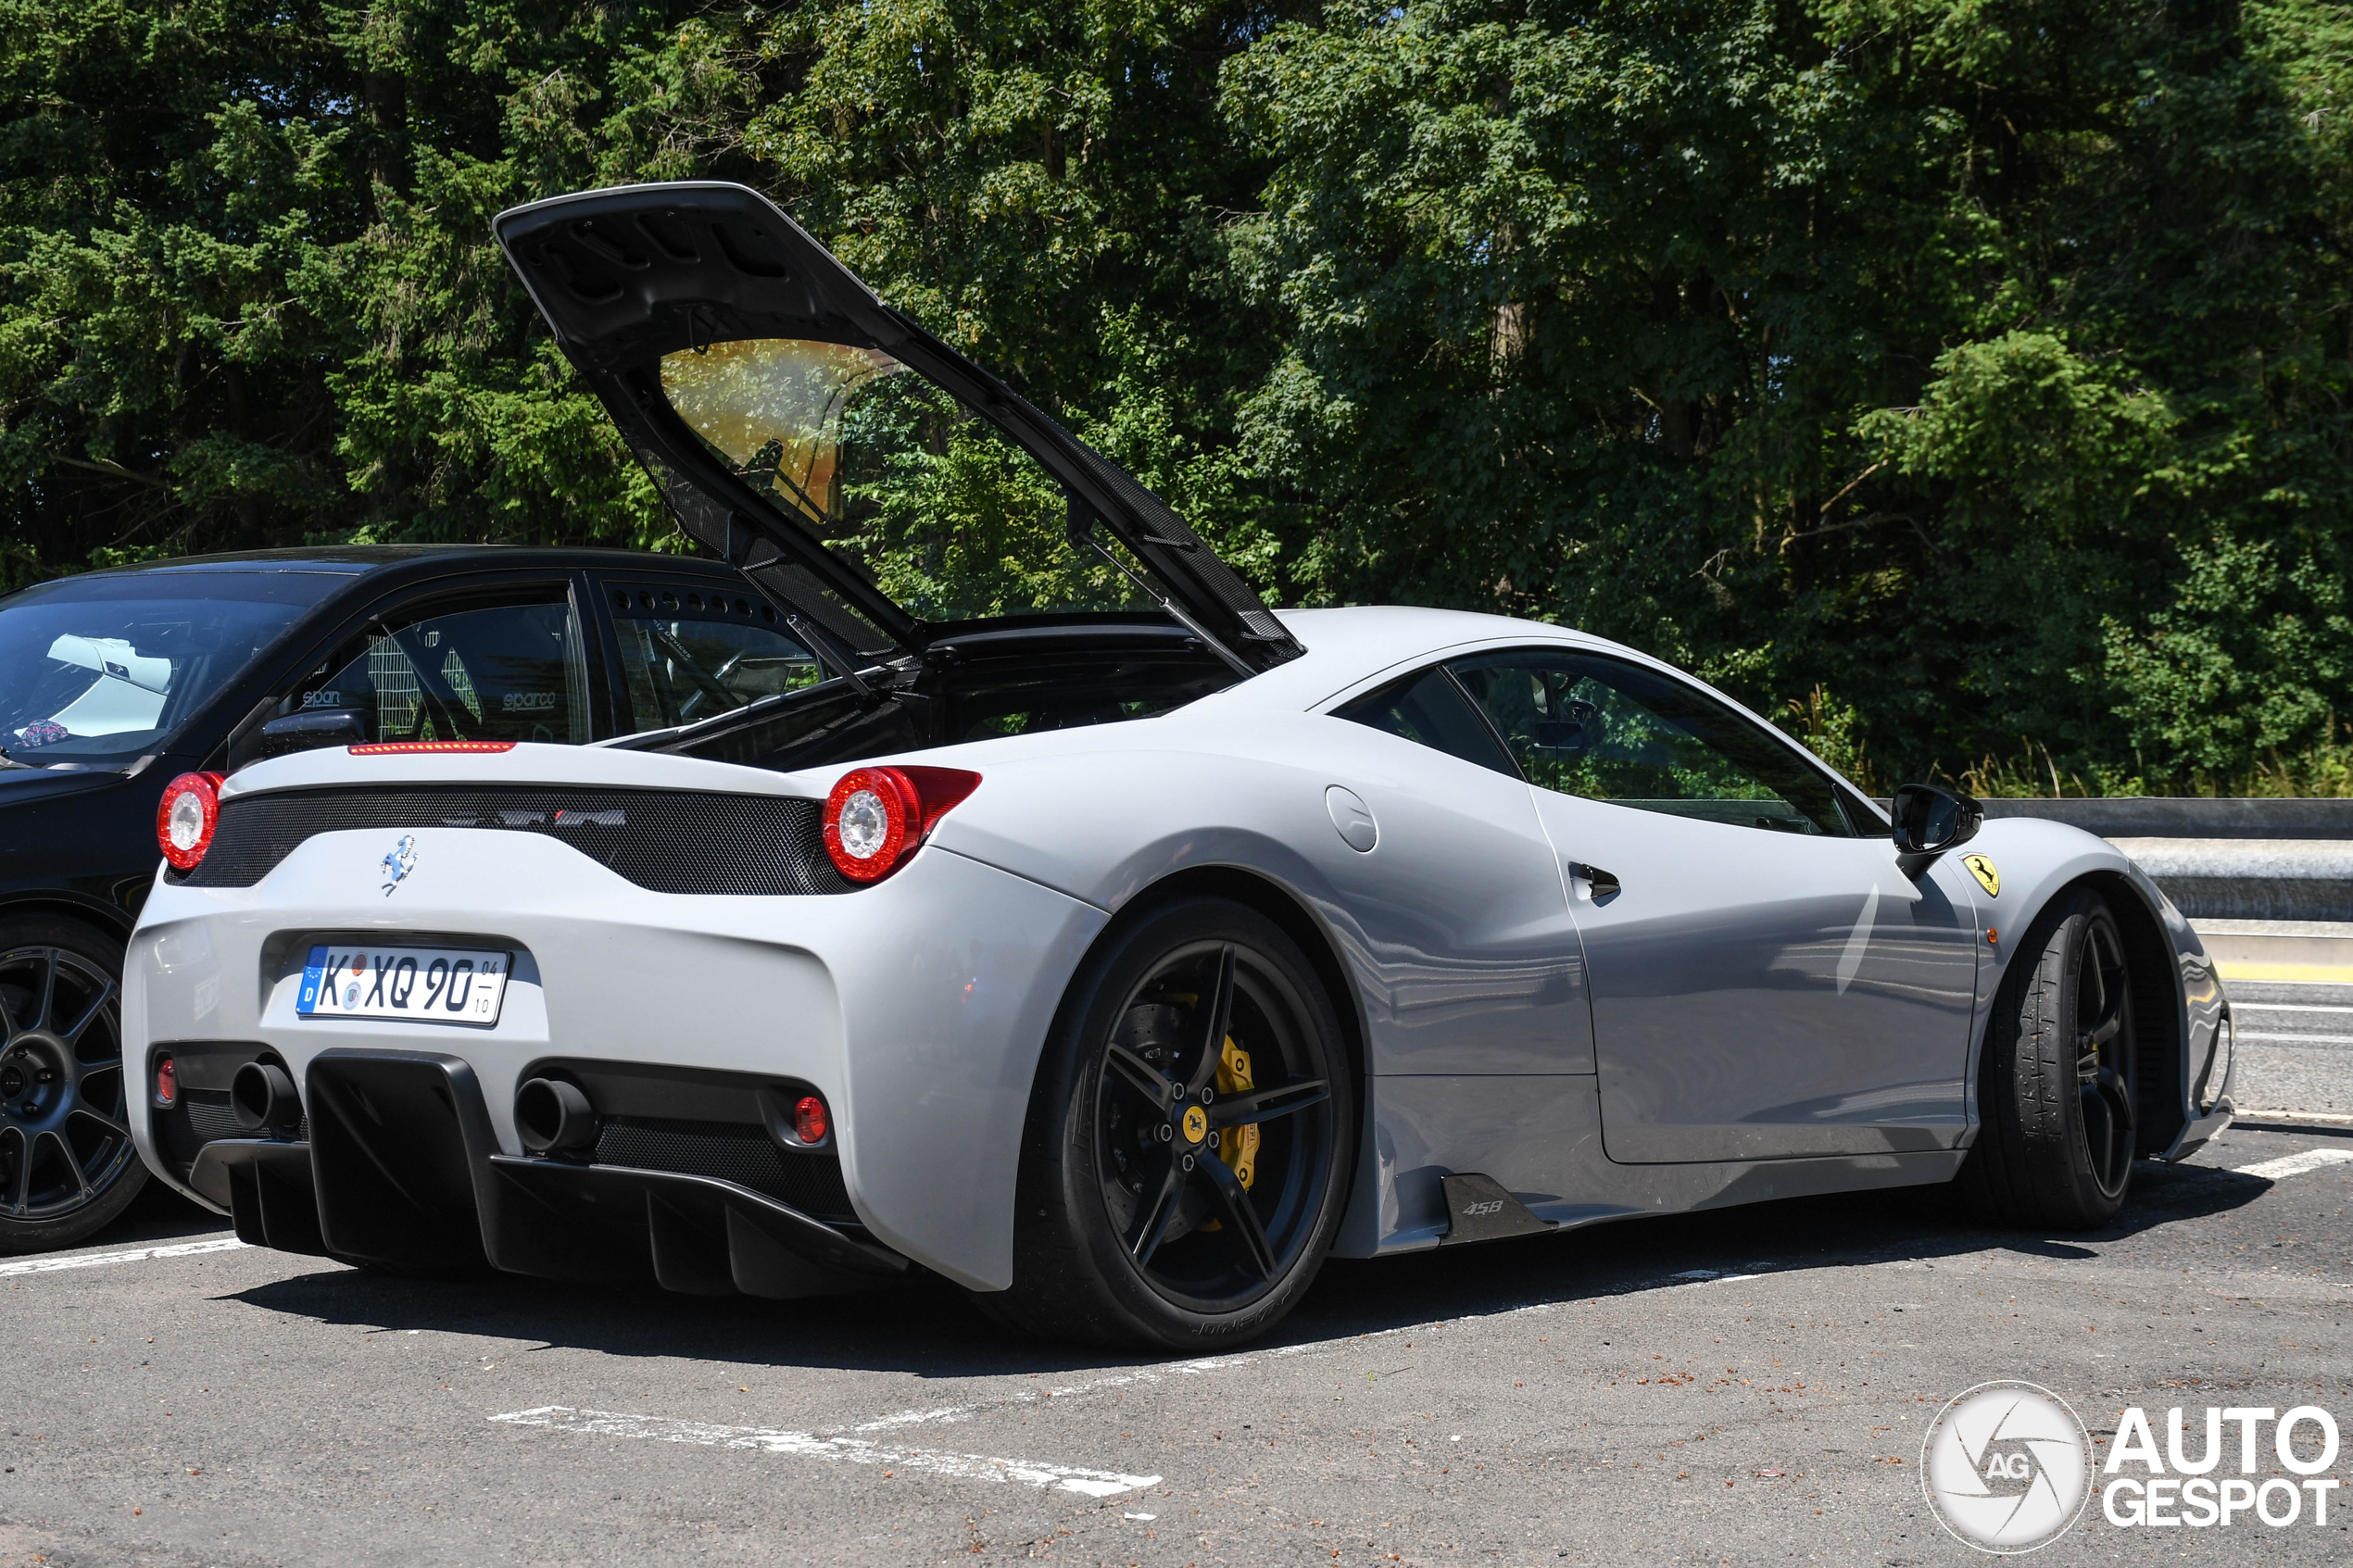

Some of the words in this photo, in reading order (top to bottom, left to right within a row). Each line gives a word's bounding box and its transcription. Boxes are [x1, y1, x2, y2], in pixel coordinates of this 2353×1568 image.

[664, 631, 691, 659] Devices
[503, 691, 556, 712] sparco
[481, 960, 497, 976] 04
[304, 987, 314, 1002] D
[319, 955, 349, 1006] K
[364, 956, 418, 1010] XQ
[423, 958, 474, 1012] 90
[474, 998, 489, 1013] 10
[1462, 1200, 1504, 1215] 458
